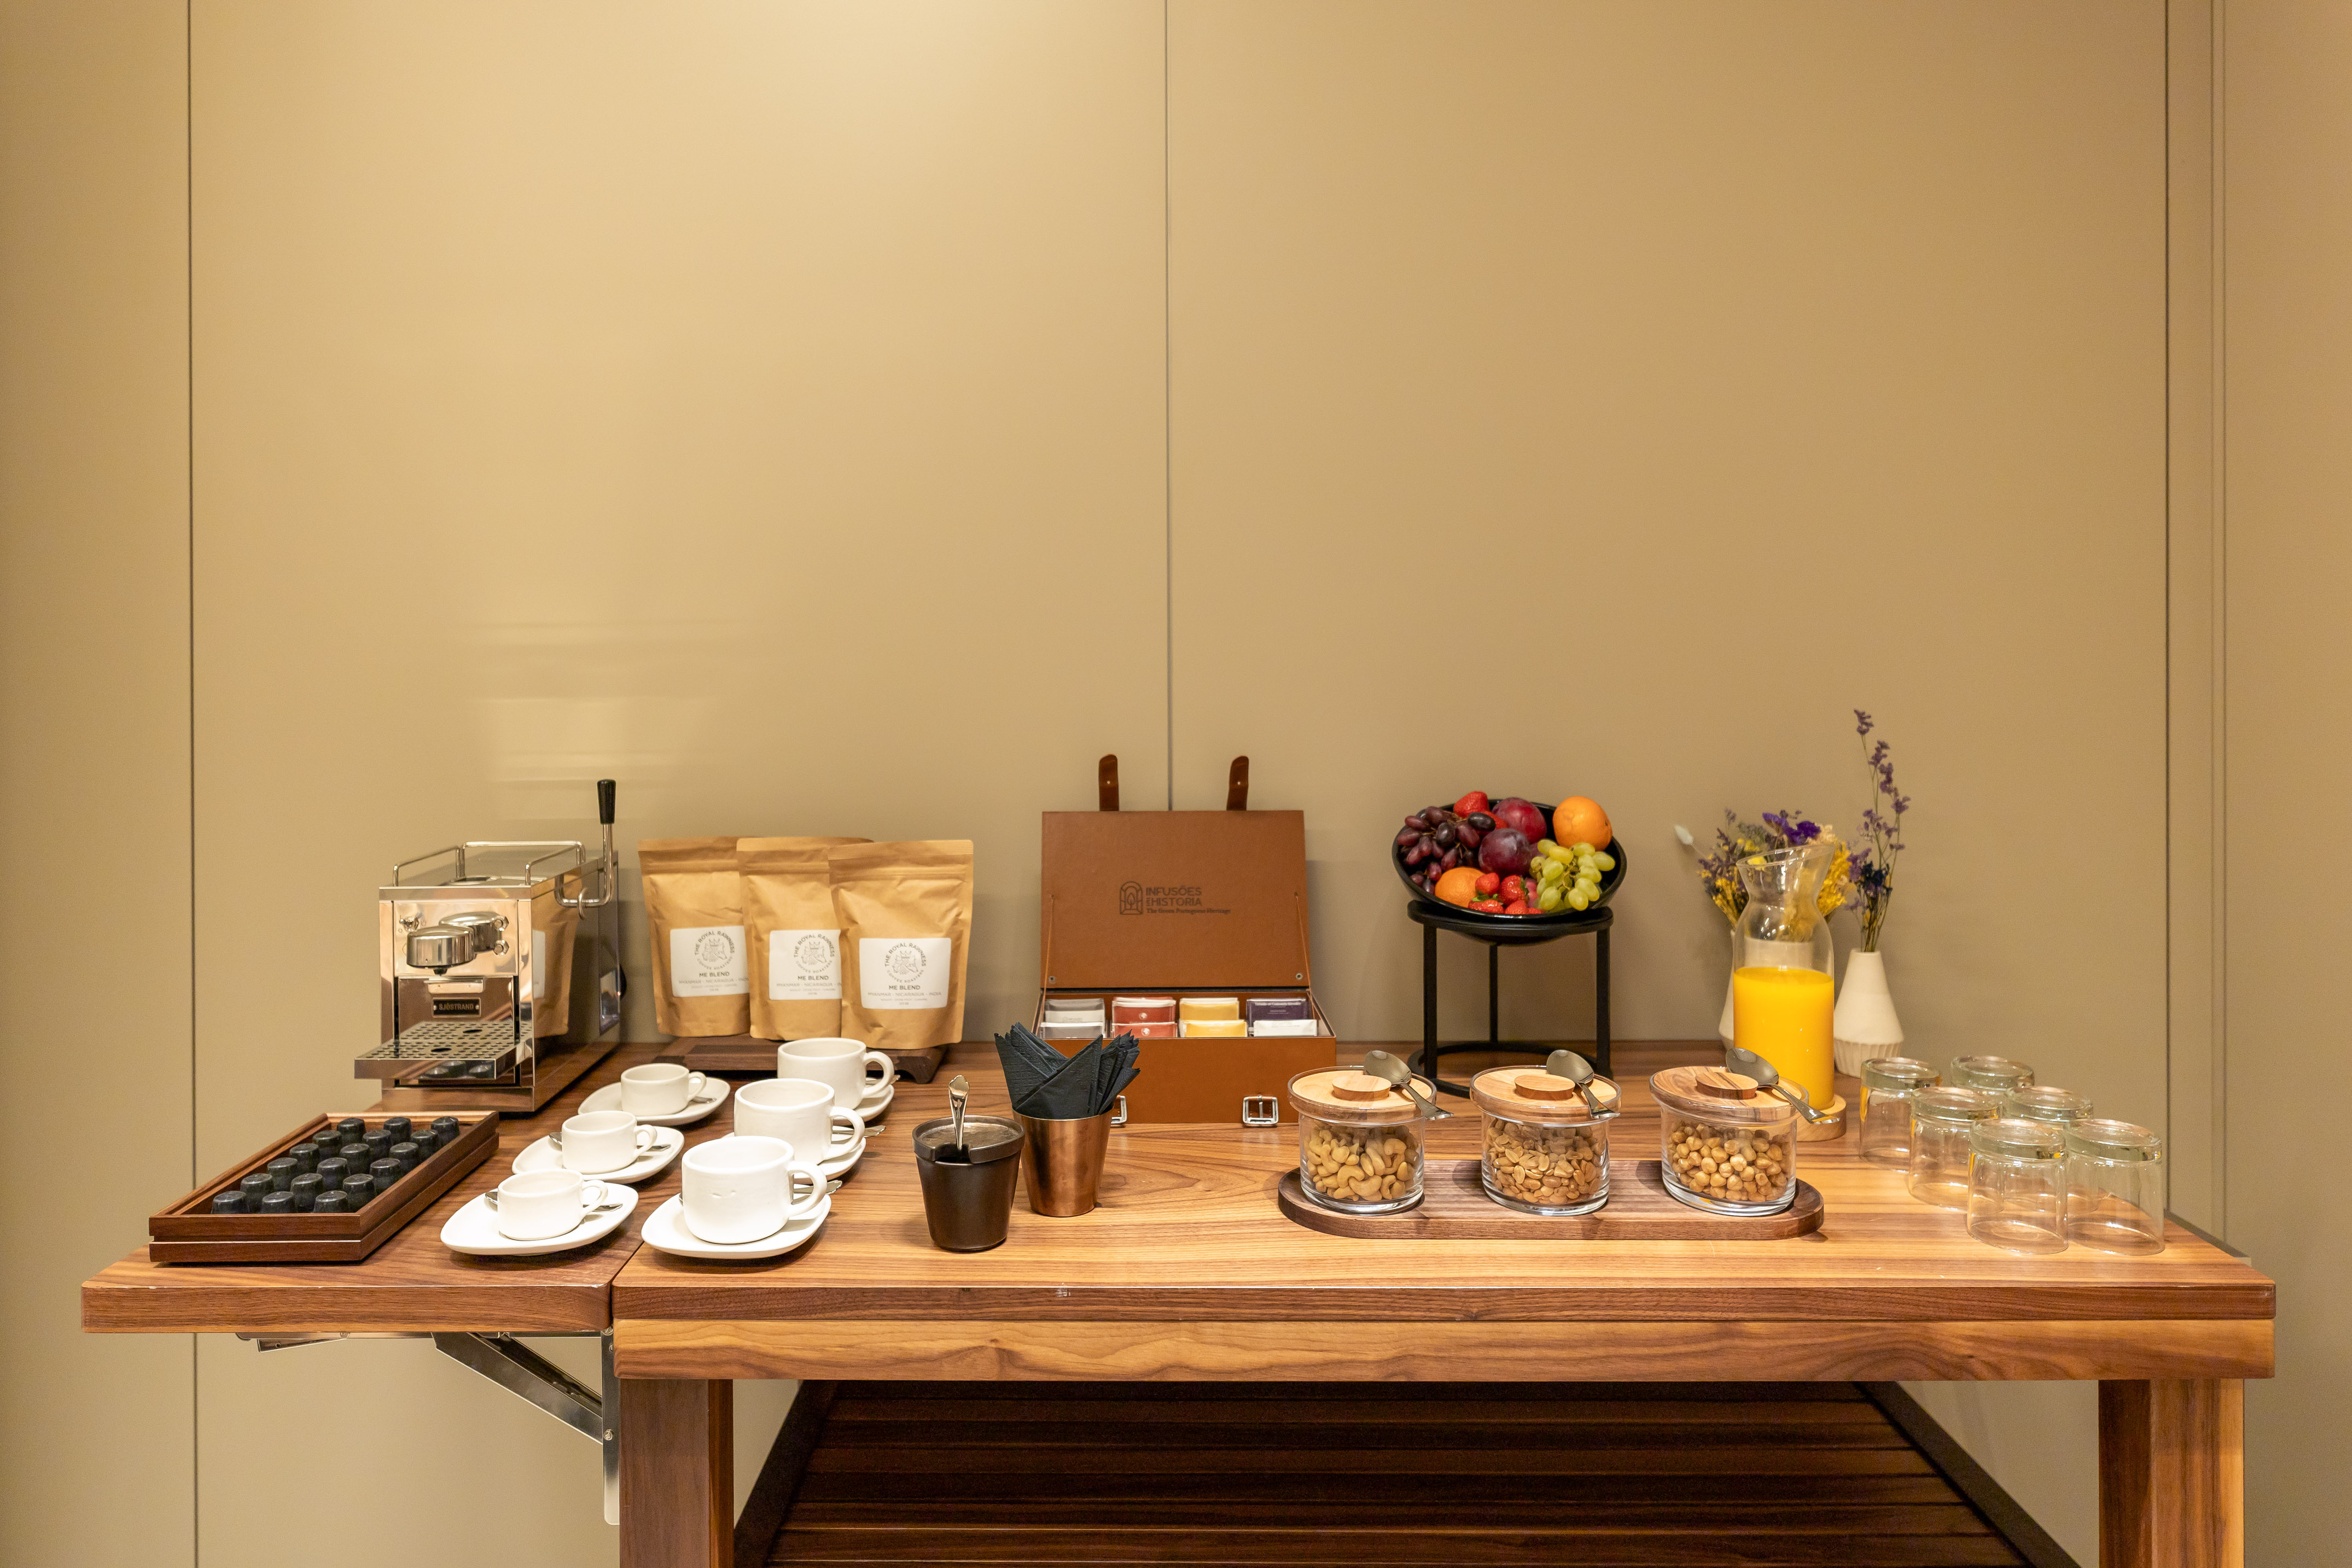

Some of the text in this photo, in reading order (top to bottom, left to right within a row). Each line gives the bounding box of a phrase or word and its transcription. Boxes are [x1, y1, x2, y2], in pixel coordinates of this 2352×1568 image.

[1146, 885, 1202, 896] INFUSÕES
[698, 931, 715, 943] ROYAL
[798, 934, 816, 946] ROYAL
[817, 934, 835, 958] RAWNESS
[888, 942, 907, 954] ROYAL
[909, 943, 926, 967] RAWNESS
